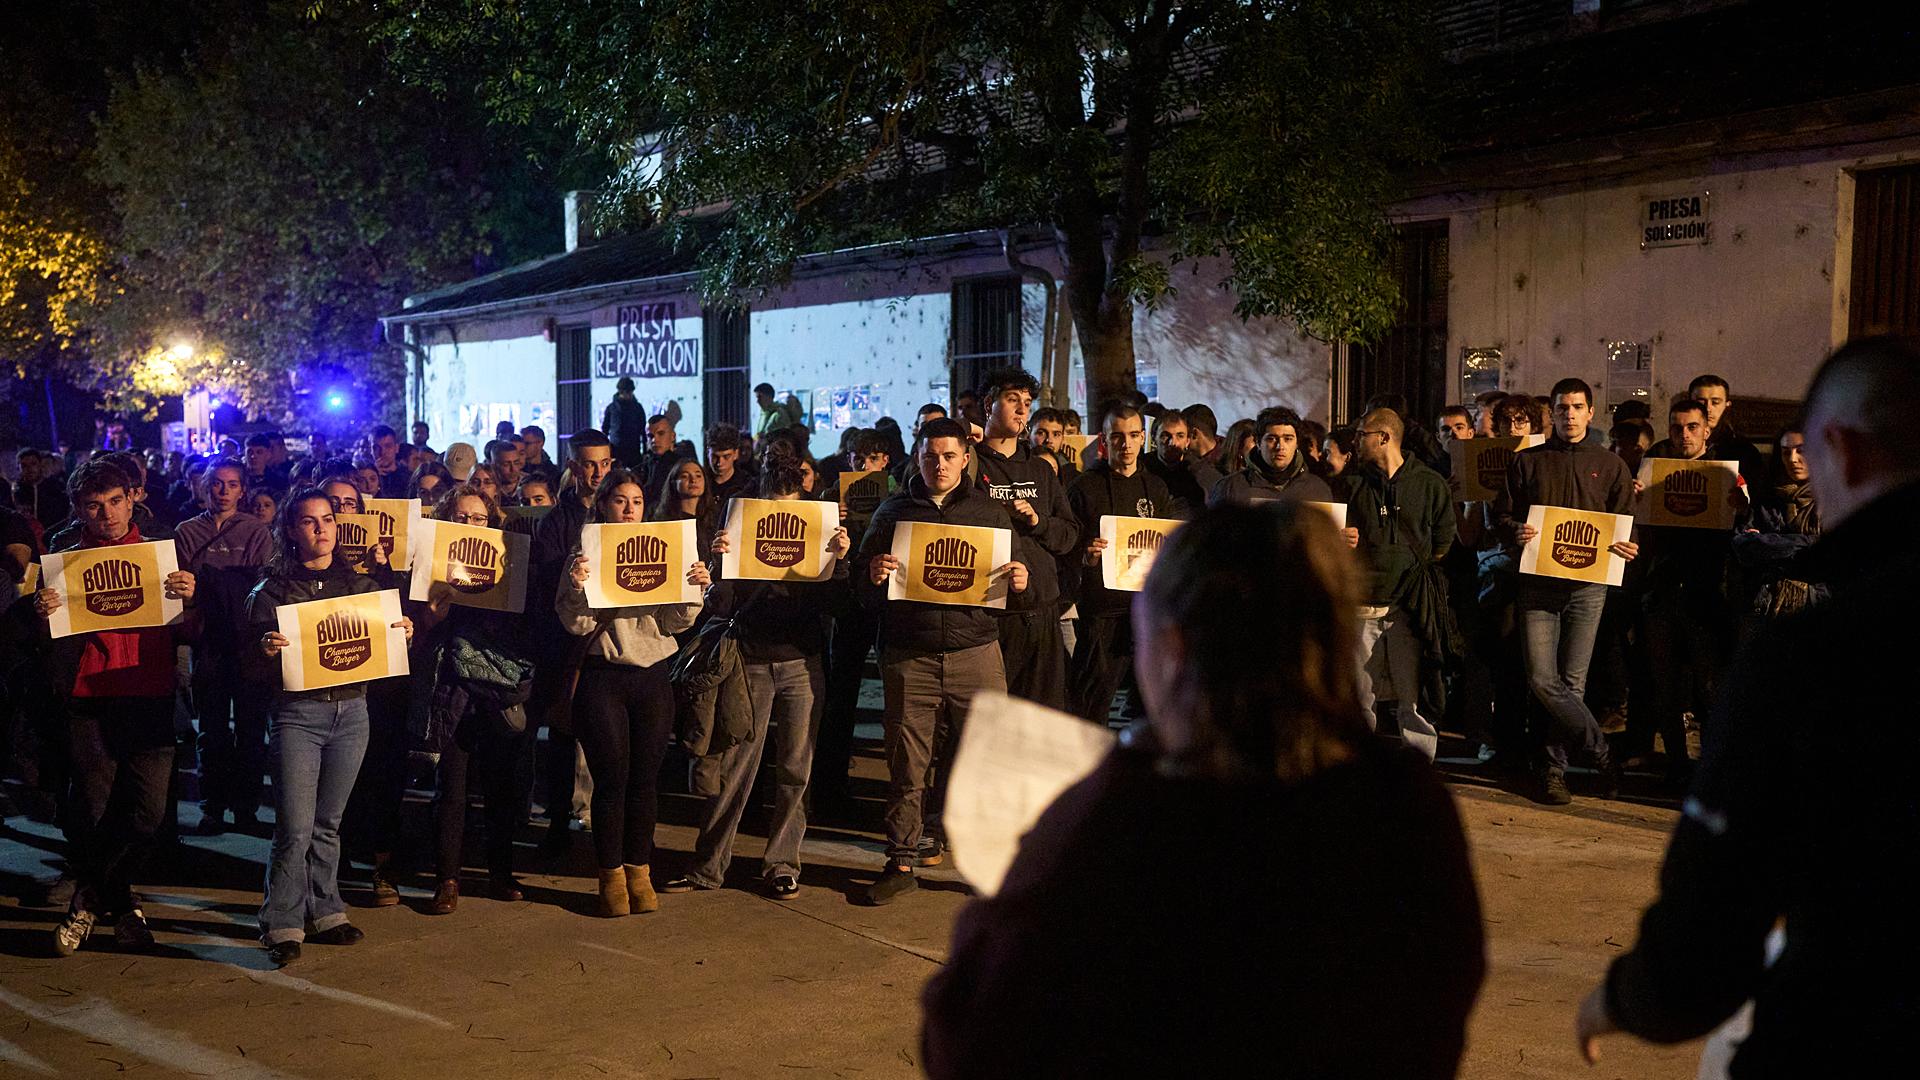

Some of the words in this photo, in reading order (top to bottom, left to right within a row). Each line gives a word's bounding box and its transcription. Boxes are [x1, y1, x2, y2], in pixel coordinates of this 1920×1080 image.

[1649, 197, 1701, 221] PRESA
[1645, 221, 1705, 242] SOLUCIÓN
[620, 303, 674, 340] PRESA
[596, 338, 697, 377] REPARACION
[1664, 469, 1709, 493] BOIKOT
[336, 523, 368, 545] OIKOT
[756, 512, 807, 540] BOIKOT
[1553, 520, 1601, 547] BOIKOT
[448, 537, 499, 568] BOIKOT
[616, 535, 668, 564] BOIKOT
[760, 542, 800, 553] Champions
[766, 551, 793, 563] Burger
[924, 537, 978, 568] BOIKOT
[82, 559, 142, 593] BOIKOT
[620, 568, 662, 579] Champions
[627, 577, 656, 588] Burger
[928, 568, 969, 580] Champions
[934, 577, 962, 589] Burger
[92, 593, 137, 605] Champions
[100, 600, 132, 612] Burger
[316, 609, 369, 644] BOIKOT
[324, 644, 366, 660] Champions
[332, 654, 361, 667] Burger
